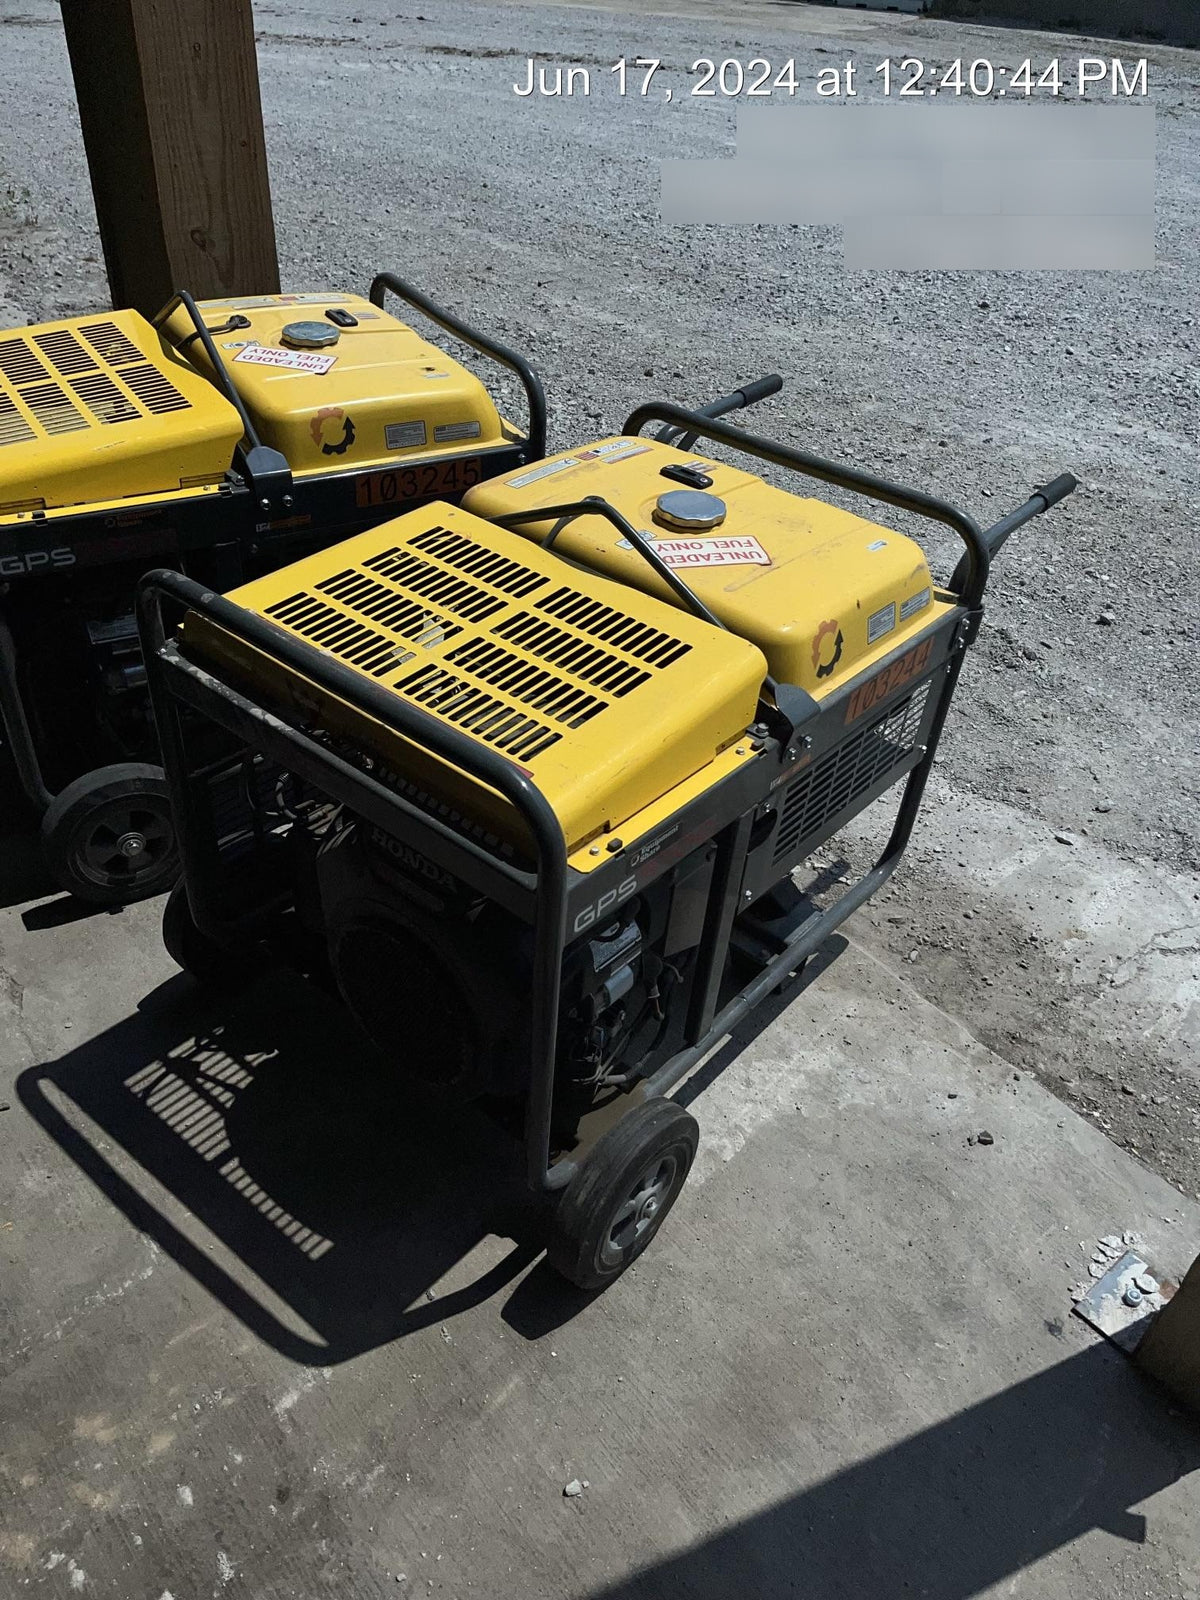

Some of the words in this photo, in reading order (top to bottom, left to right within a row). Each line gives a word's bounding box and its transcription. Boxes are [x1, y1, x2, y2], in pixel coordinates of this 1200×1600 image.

[250, 348, 289, 357] ONLY
[295, 353, 330, 364] FUEL
[242, 354, 324, 370] UNLEADED
[360, 459, 480, 504] 103245
[657, 541, 703, 552] ONLY
[706, 539, 754, 549] FUEL
[0, 547, 77, 576] GPS
[663, 551, 763, 564] UNLEADED
[851, 636, 931, 720] 103244
[573, 873, 638, 933] GPS
